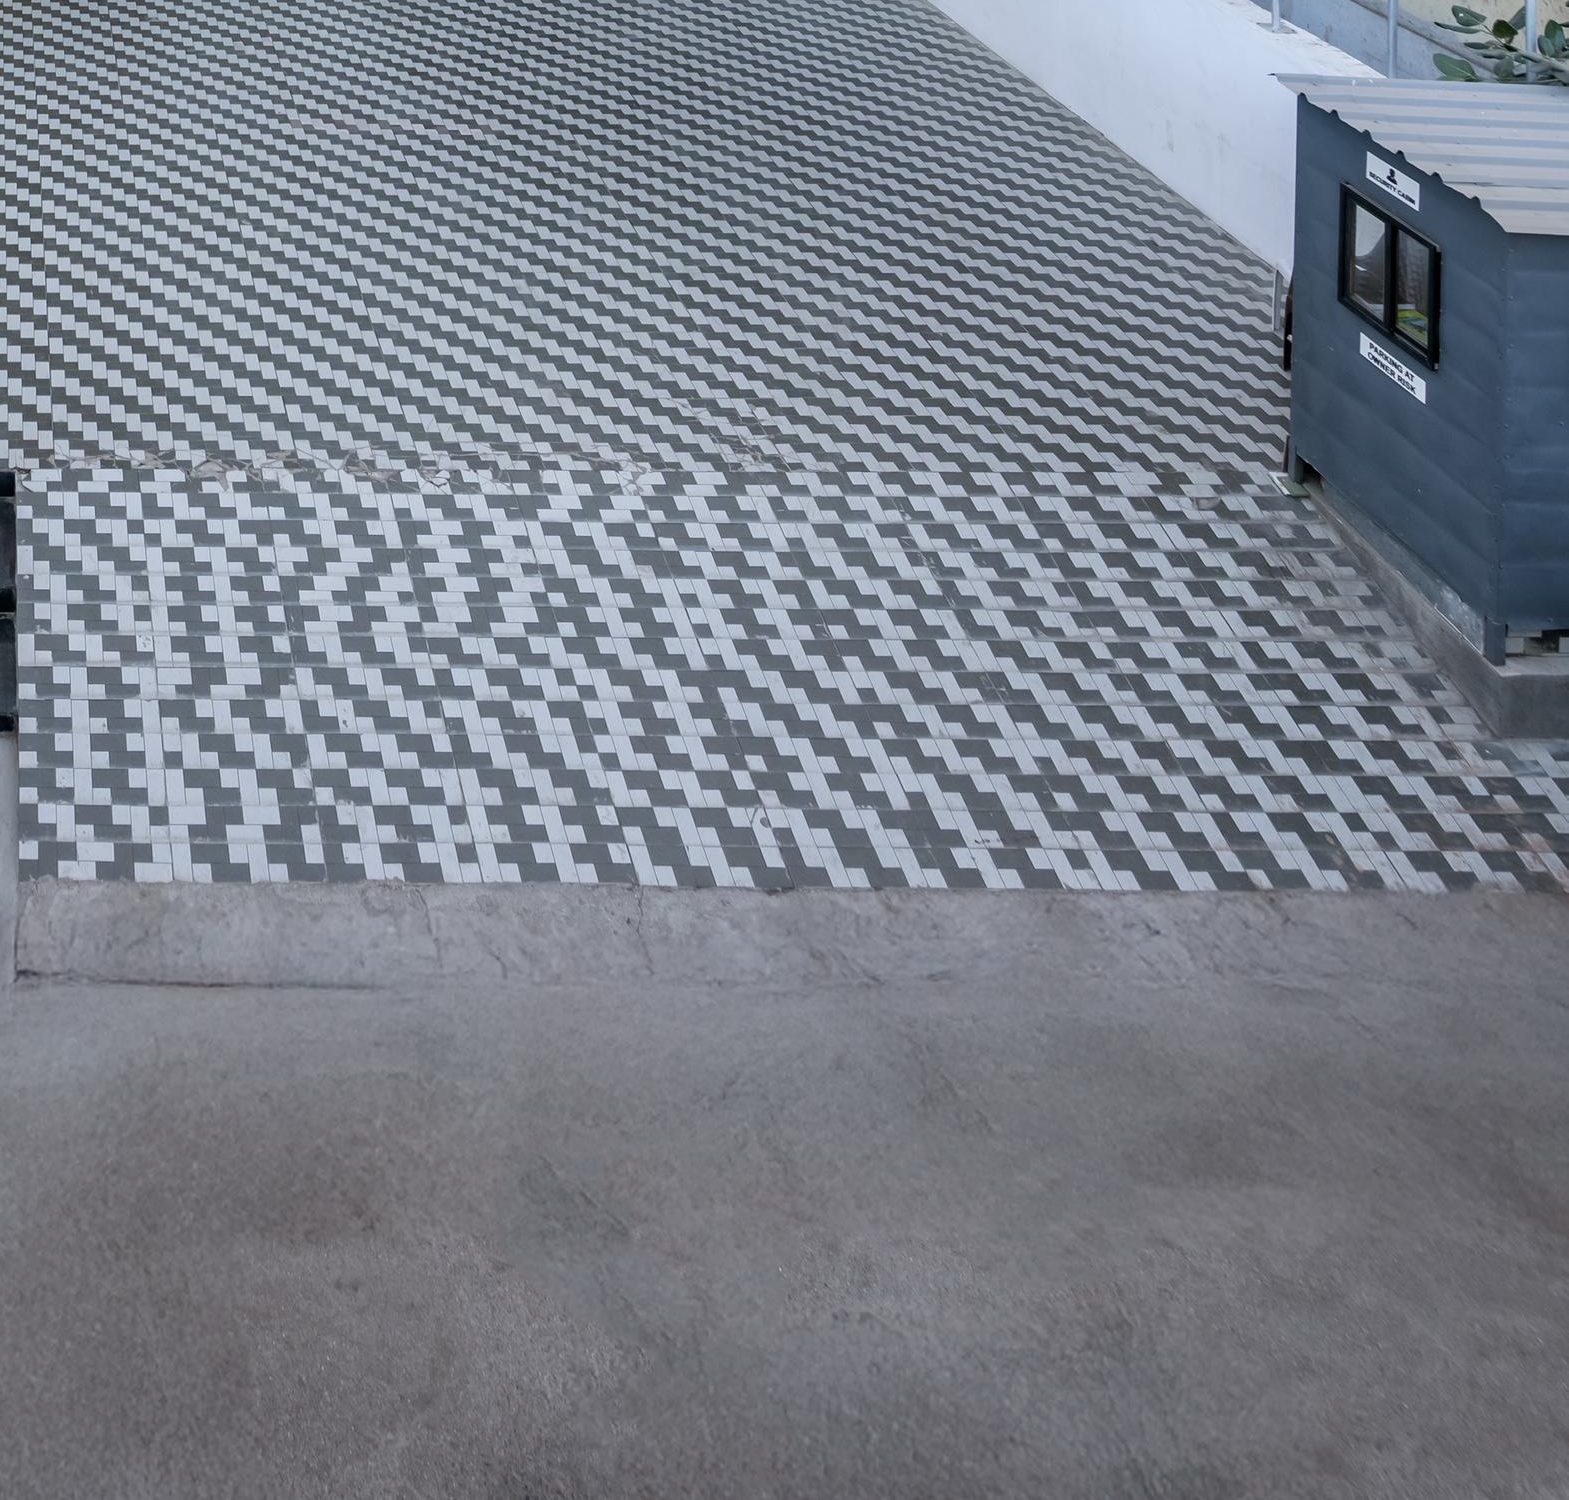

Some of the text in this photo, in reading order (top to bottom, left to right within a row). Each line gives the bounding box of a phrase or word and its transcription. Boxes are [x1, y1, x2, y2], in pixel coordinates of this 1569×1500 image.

[1367, 352, 1417, 395] OWNER RISK
[1369, 342, 1415, 382] PARKING AT
